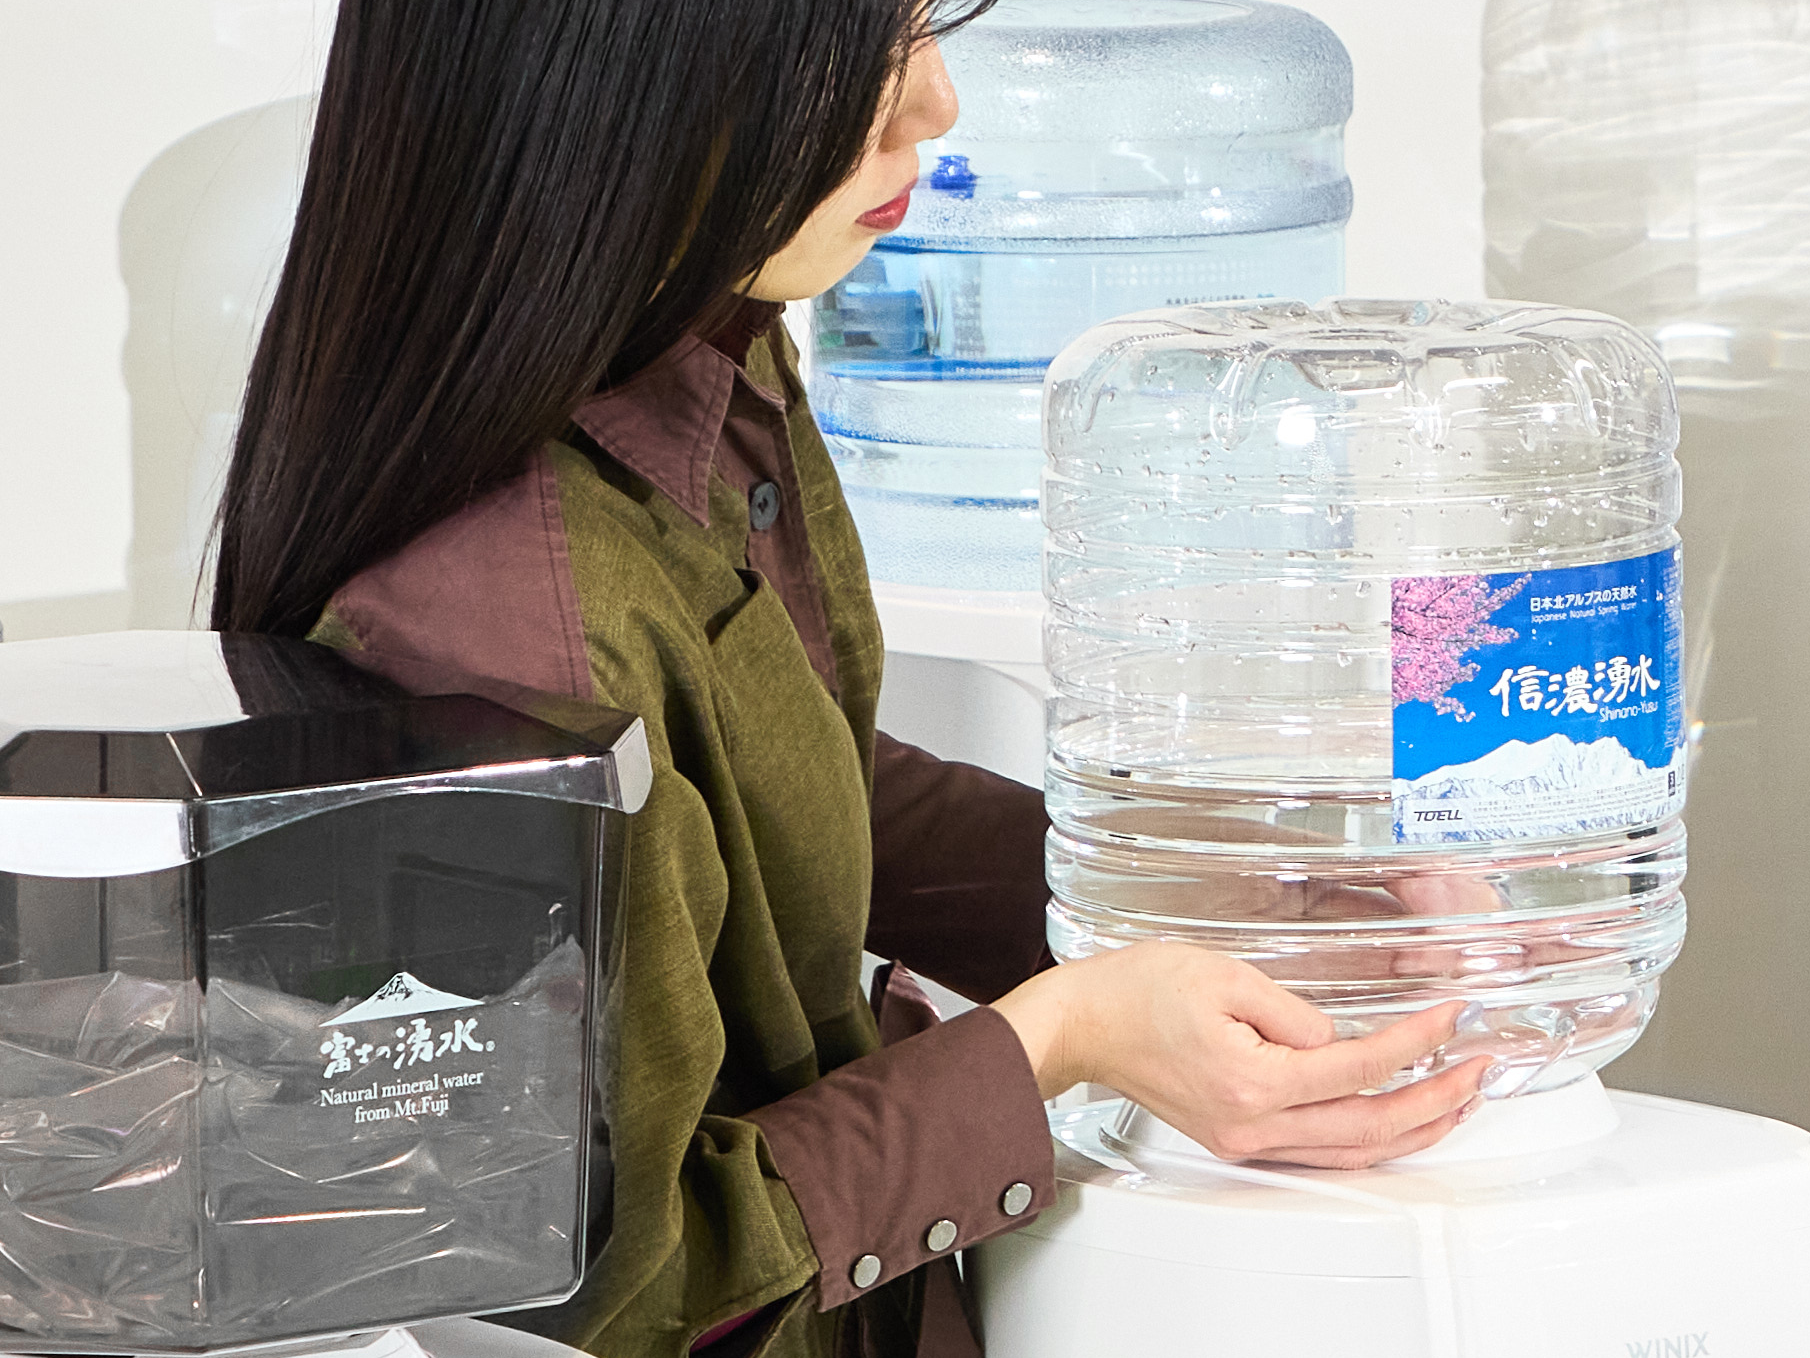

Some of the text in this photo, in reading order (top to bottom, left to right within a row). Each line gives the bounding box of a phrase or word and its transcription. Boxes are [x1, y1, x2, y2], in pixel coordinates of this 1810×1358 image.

[1530, 585, 1638, 612] 日本北アルプスの天然水
[1489, 654, 1661, 717] 信濃湧水
[1413, 809, 1464, 823] TOELL
[320, 1071, 484, 1107] Natural mineral water
[354, 1094, 449, 1124] from Mt.Fuji
